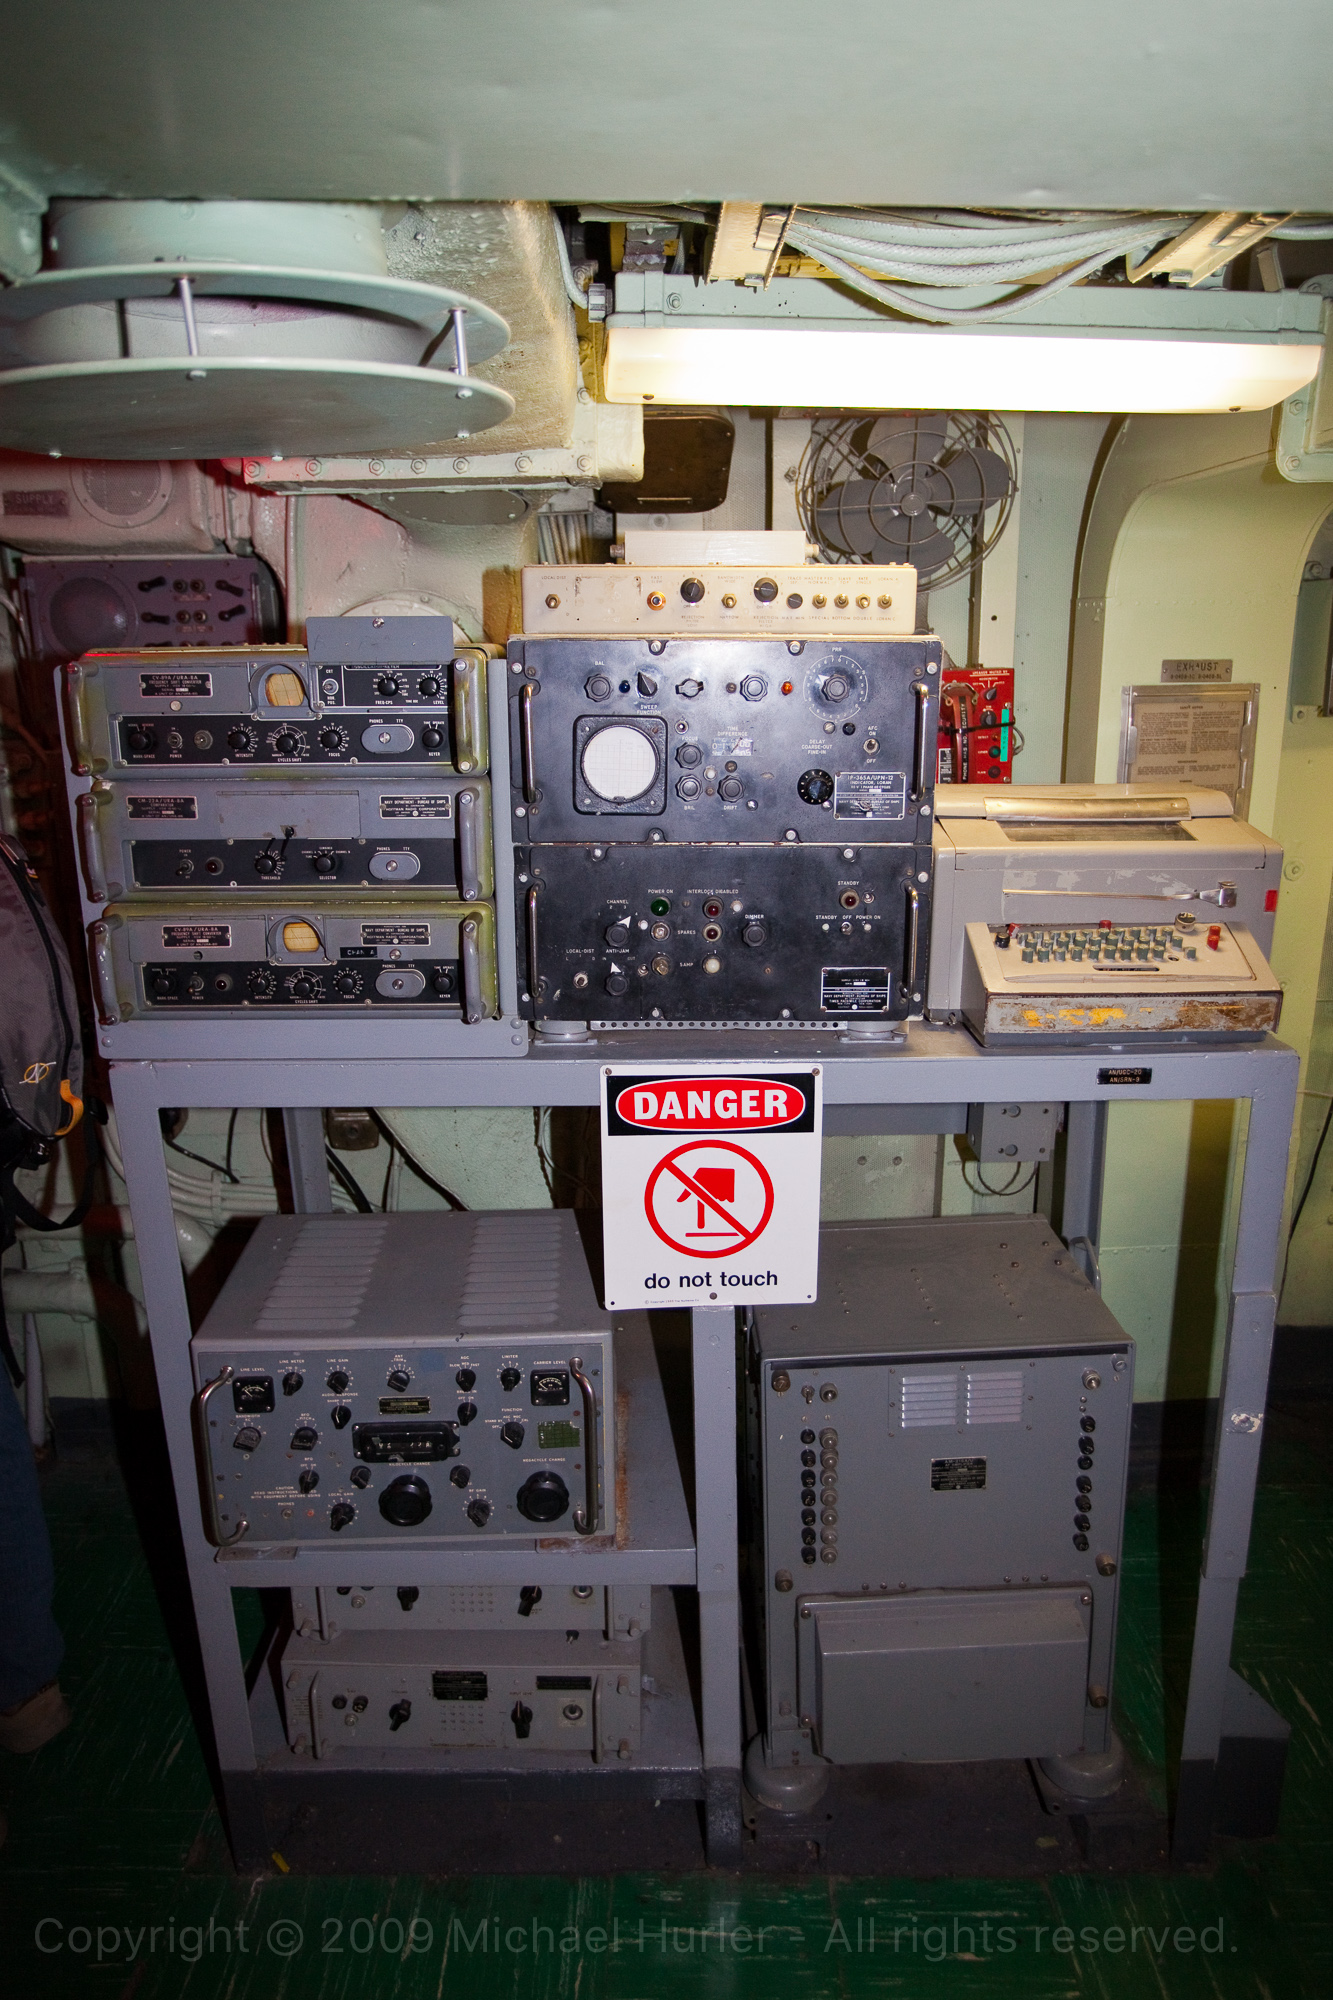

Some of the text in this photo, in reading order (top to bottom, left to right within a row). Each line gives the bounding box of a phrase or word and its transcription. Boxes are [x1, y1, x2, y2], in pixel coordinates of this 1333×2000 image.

[16, 494, 54, 504] SUPPLY
[1176, 662, 1219, 671] EXHAUST
[634, 1089, 788, 1120] DANGER
[644, 1270, 778, 1289] do not touch
